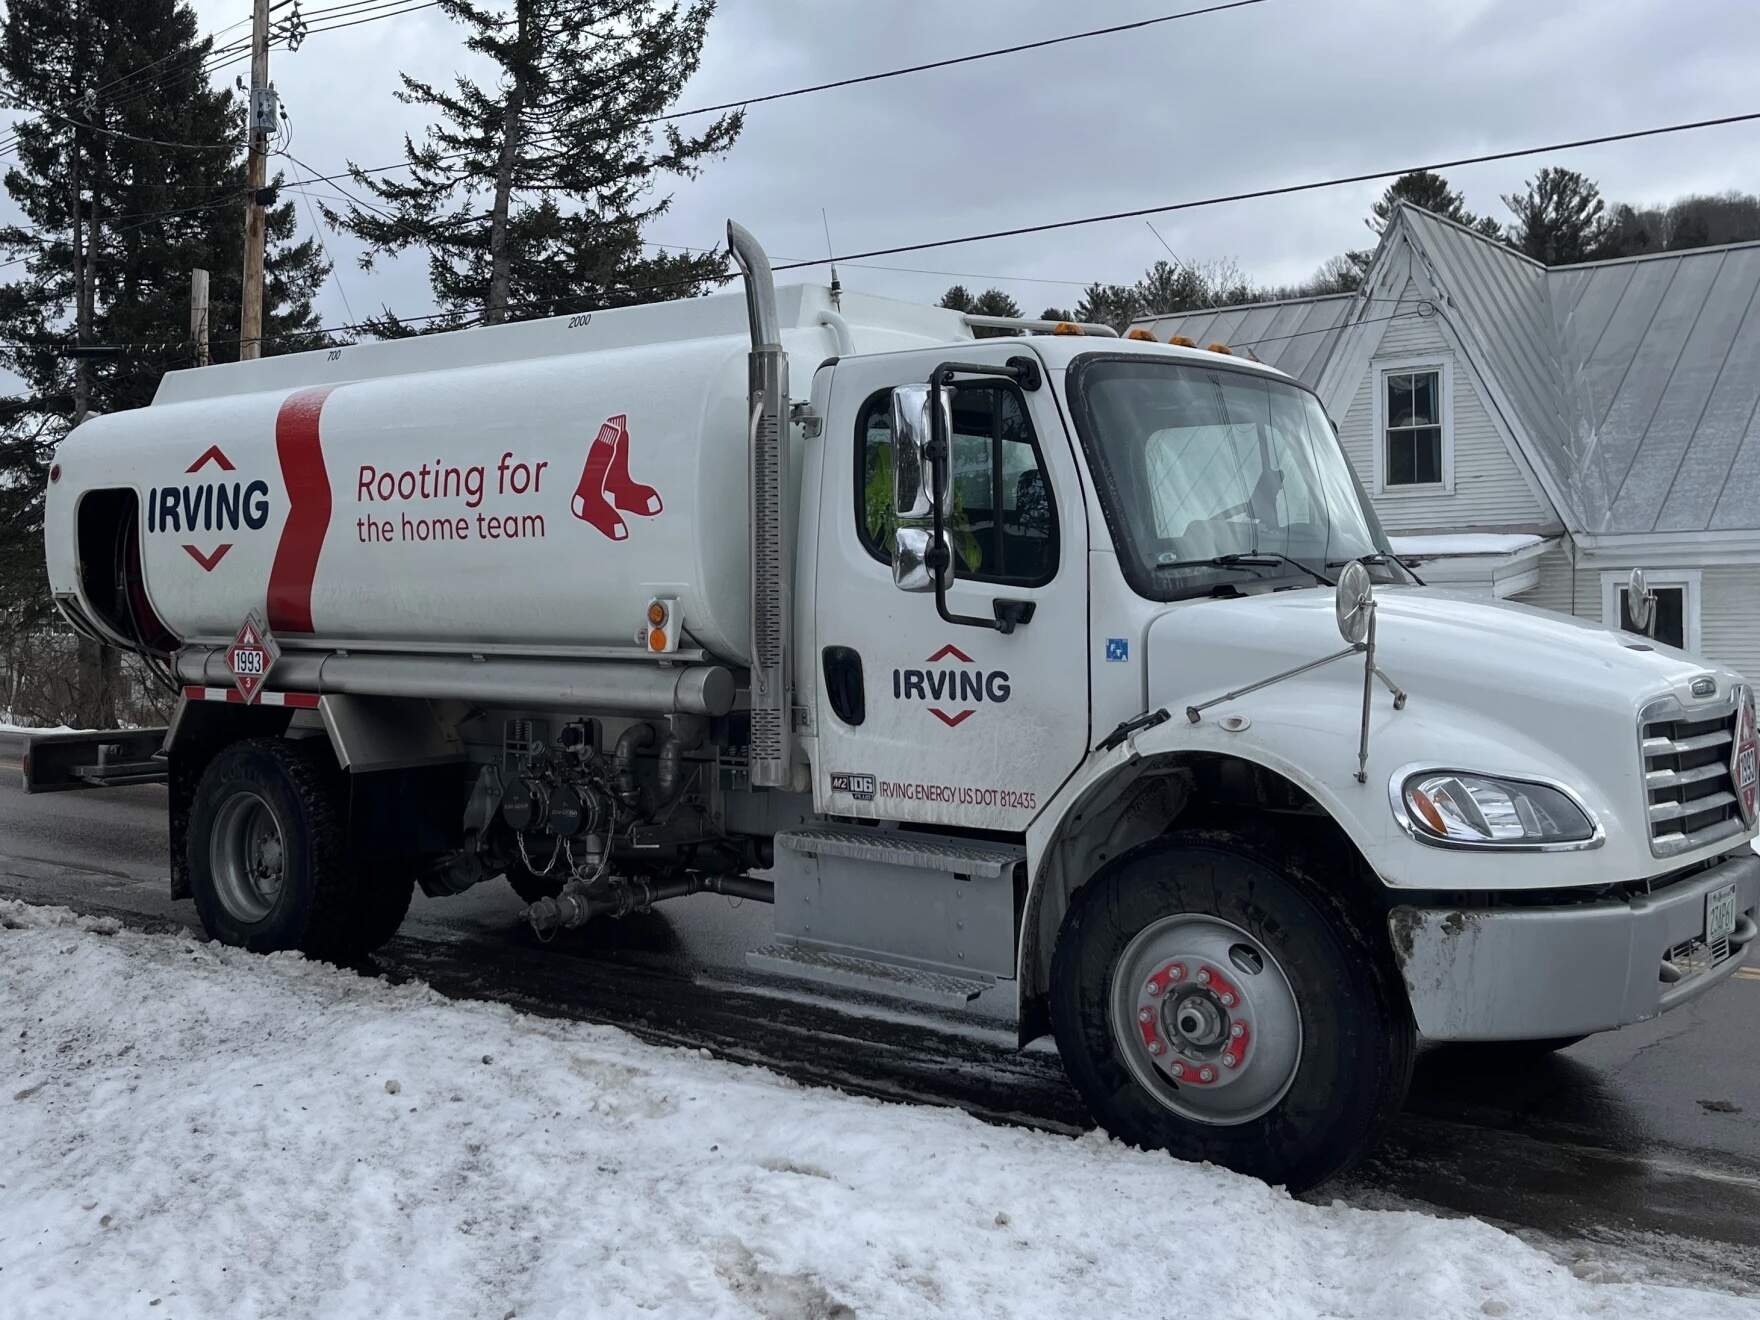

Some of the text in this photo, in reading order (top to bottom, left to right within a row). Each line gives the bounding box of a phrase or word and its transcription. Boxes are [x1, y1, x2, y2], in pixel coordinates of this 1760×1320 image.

[568, 314, 591, 328] 2000
[327, 351, 341, 362] 700
[358, 452, 548, 508] Rooting for
[148, 480, 269, 533] IRVING
[357, 512, 545, 542] the home team
[236, 652, 261, 673] 1993
[245, 677, 251, 688] 3
[893, 669, 1011, 703] IRVING
[832, 776, 873, 793] M2 106
[880, 781, 1036, 809] IRVING ENERGY US DOT 812435
